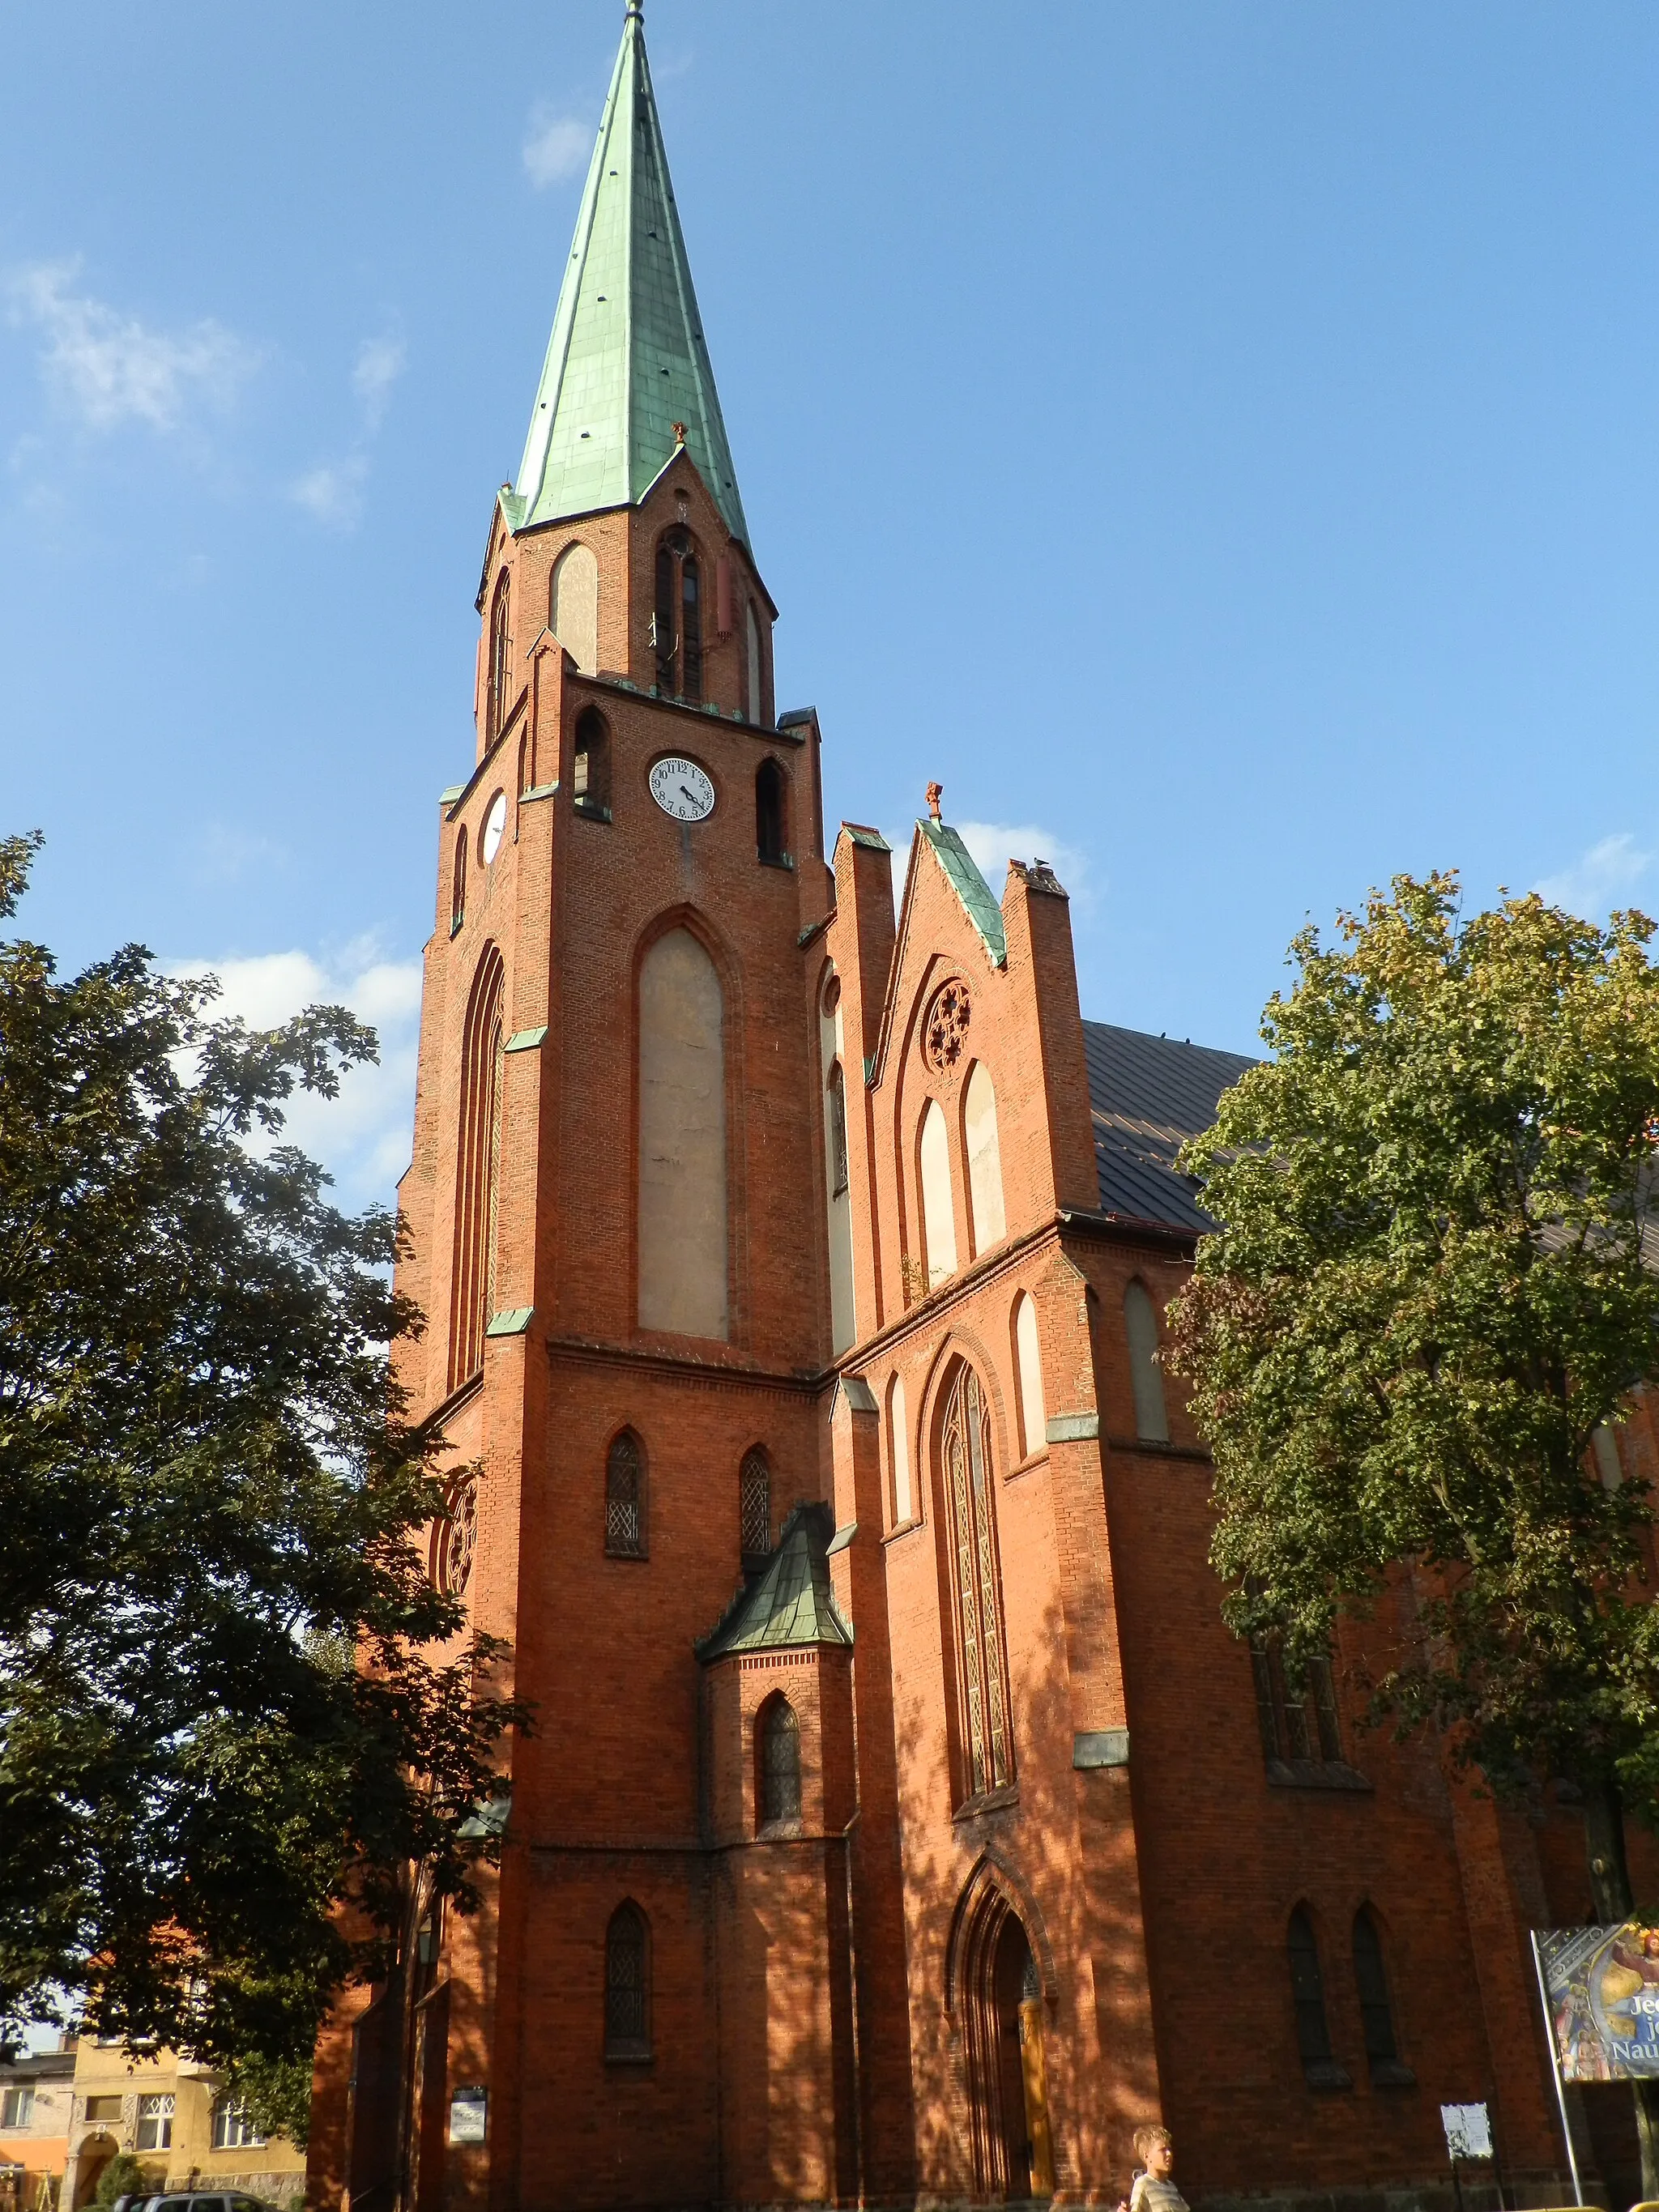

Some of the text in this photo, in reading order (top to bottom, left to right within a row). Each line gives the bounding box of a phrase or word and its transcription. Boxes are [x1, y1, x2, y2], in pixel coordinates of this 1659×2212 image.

[659, 769, 667, 779] 10
[667, 764, 675, 774] 11
[677, 764, 687, 774] 12
[691, 769, 695, 778] 1
[655, 779, 660, 788] 9
[699, 778, 705, 788] 2
[659, 791, 665, 800] 8
[703, 791, 709, 799] 3
[667, 800, 674, 811] 7
[692, 806, 697, 815] 5
[680, 806, 685, 816] 6
